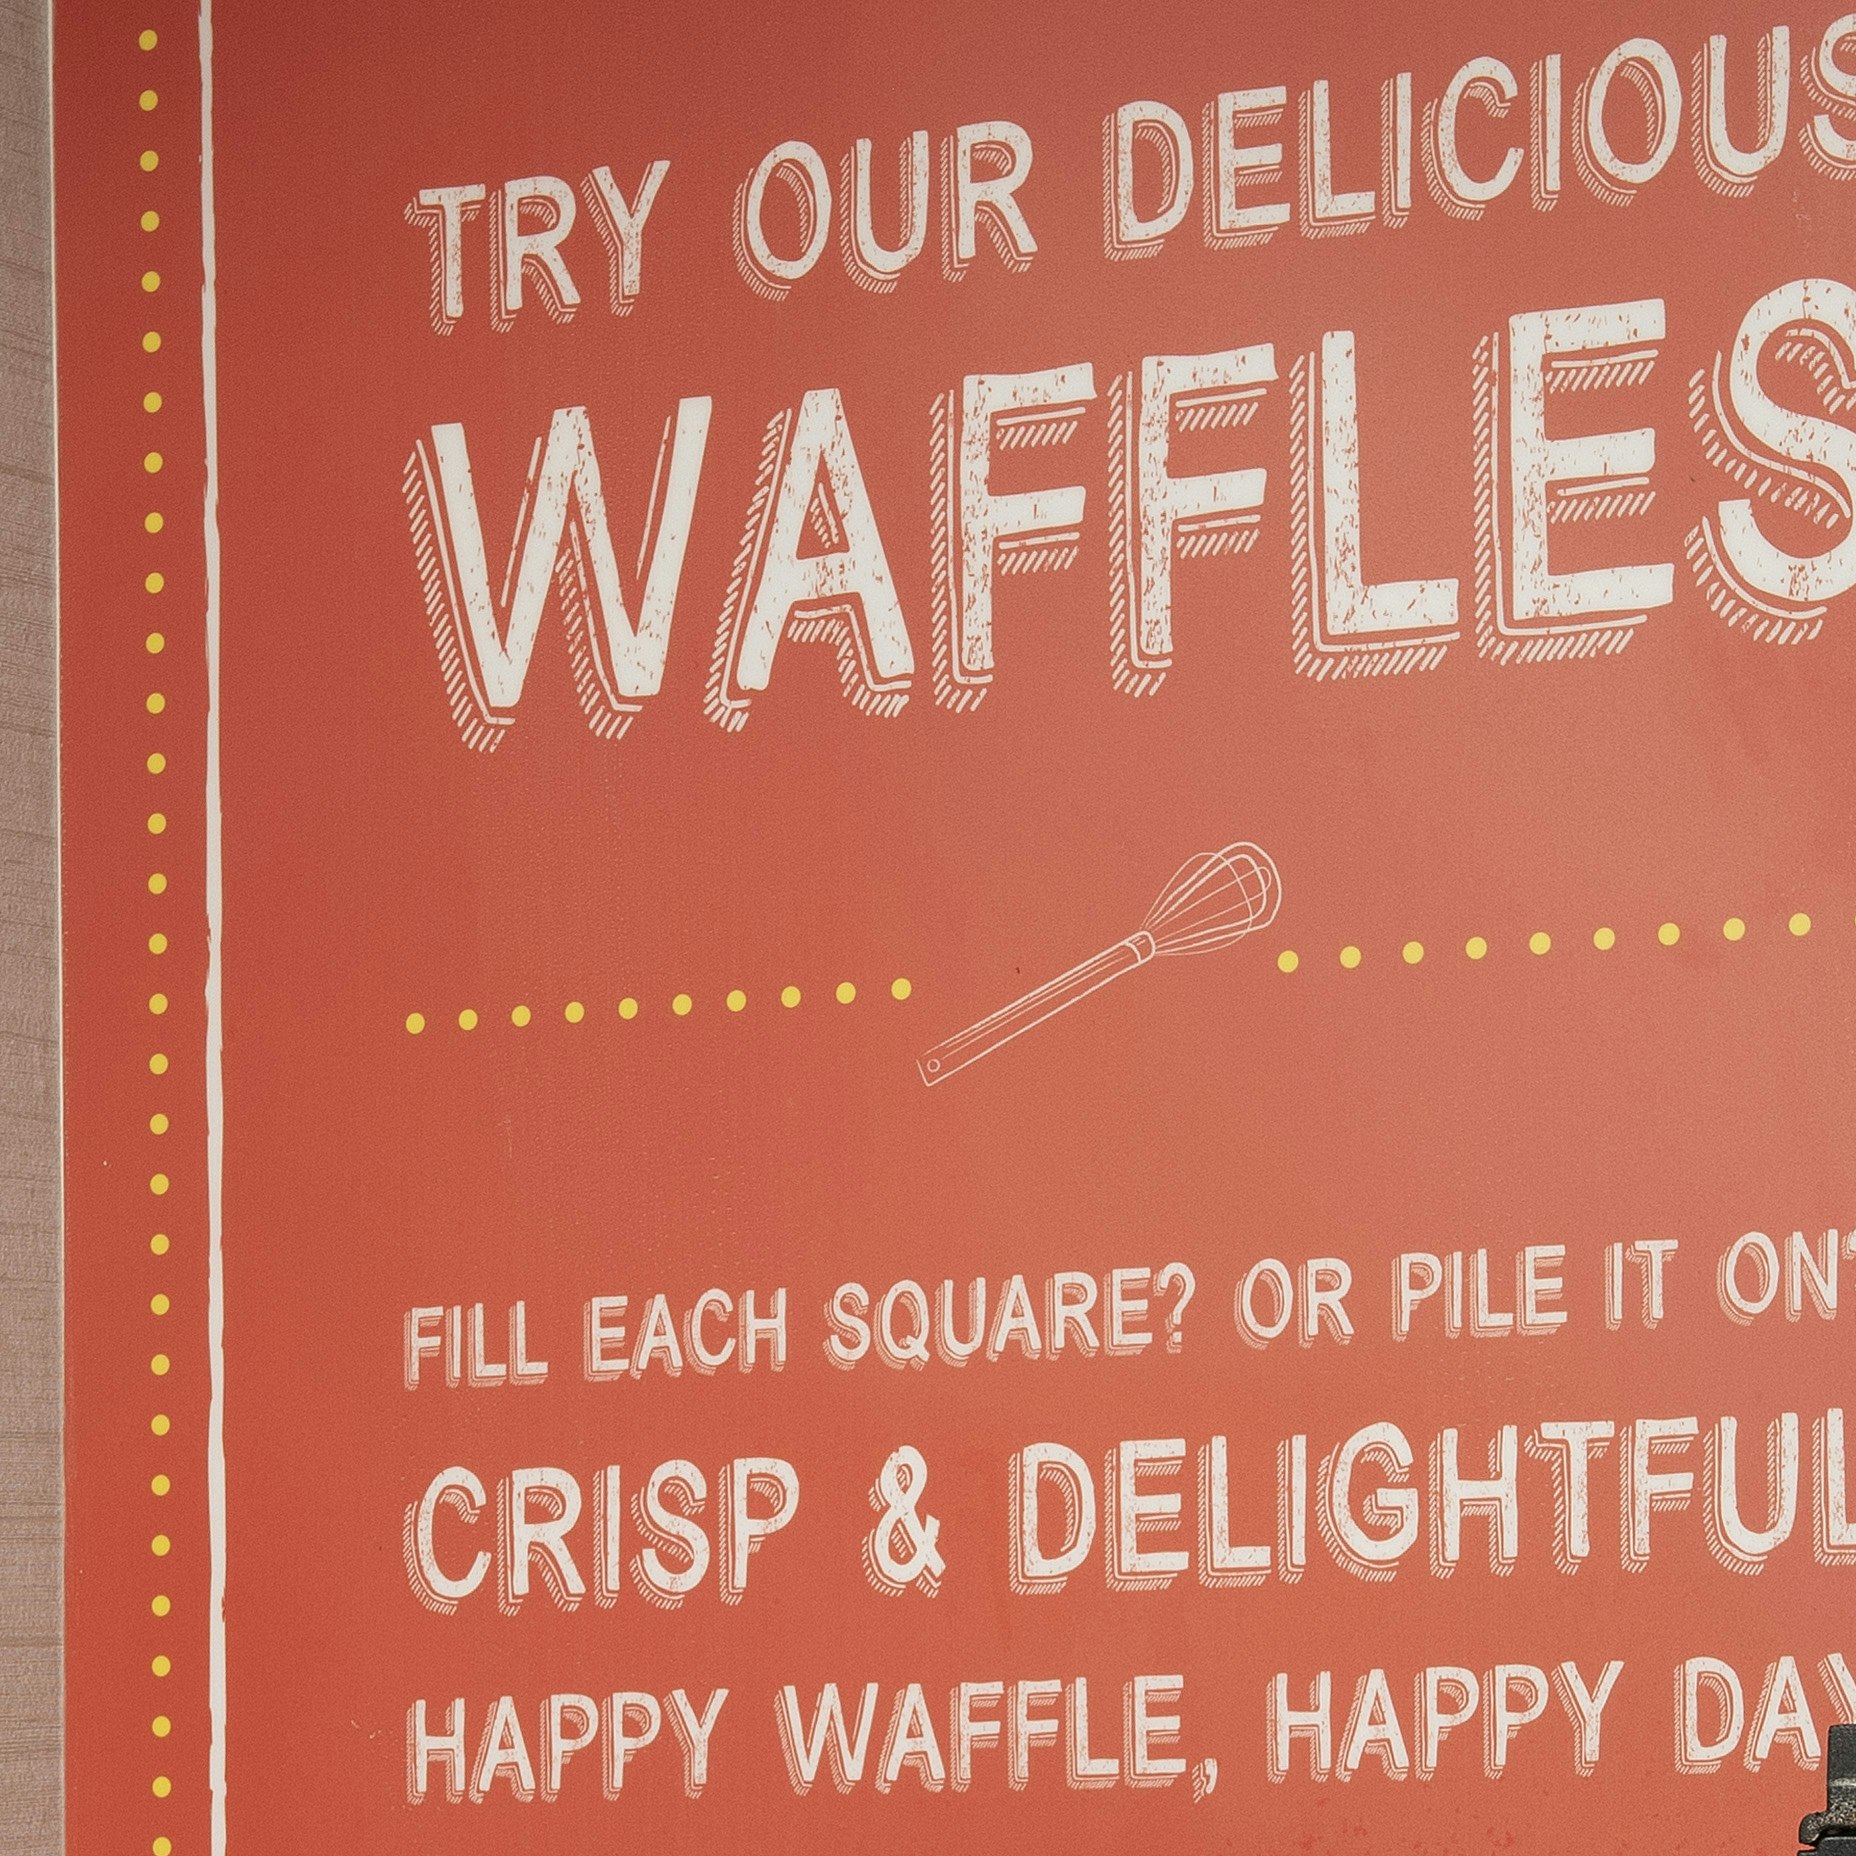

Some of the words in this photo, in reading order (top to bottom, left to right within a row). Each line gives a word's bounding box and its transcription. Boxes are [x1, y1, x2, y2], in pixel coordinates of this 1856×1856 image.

[404, 159, 671, 334] TRY
[733, 121, 1040, 300] OUR
[404, 1301, 548, 1390] FILL
[584, 1287, 787, 1382] EACH
[824, 1262, 1196, 1371] SQUARE?
[1235, 1257, 1354, 1348] OR
[1392, 1245, 1568, 1341] PILE
[1605, 1239, 1679, 1330] IT
[402, 1457, 800, 1616] CRISP
[861, 1444, 946, 1598] &
[406, 1687, 729, 1804] HAPPY
[776, 1674, 1219, 1804] WAFFLE,
[1266, 1660, 1624, 1785] HAPPY
